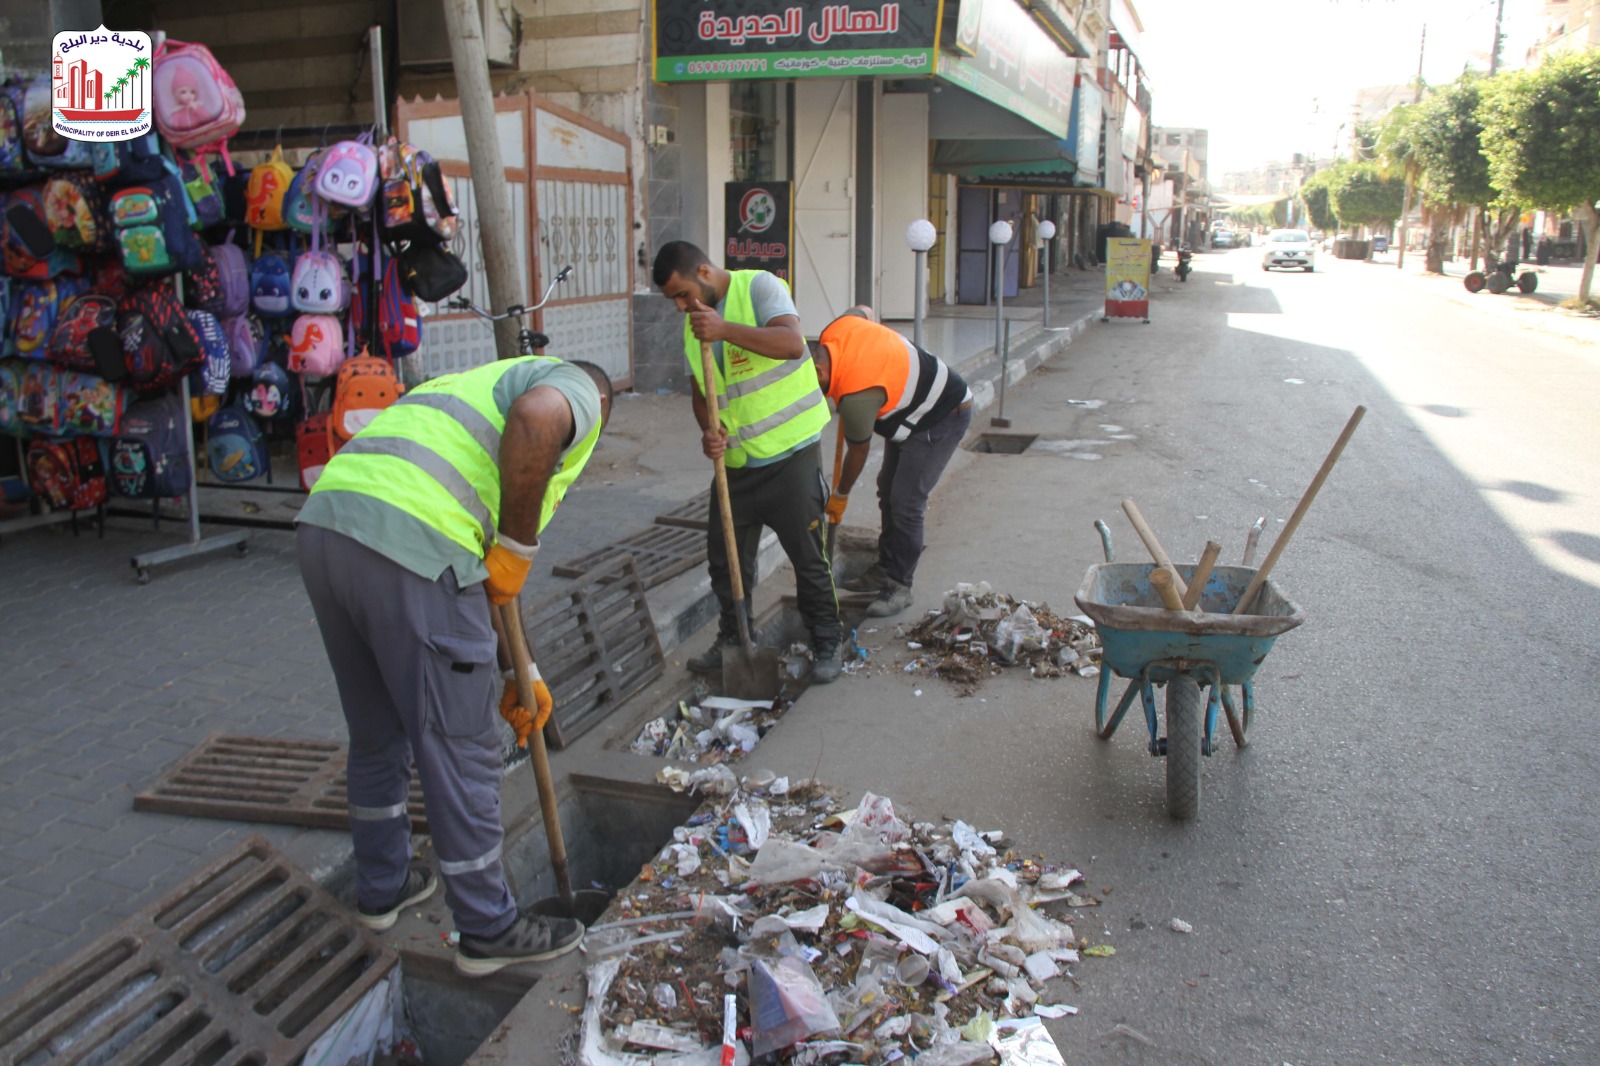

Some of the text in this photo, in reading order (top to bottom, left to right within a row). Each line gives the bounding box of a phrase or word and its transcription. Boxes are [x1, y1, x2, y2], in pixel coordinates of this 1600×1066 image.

[699, 4, 898, 45] الهلال الجديدة
[688, 59, 767, 74] 0598737771
[828, 56, 849, 67] طبية
[851, 56, 894, 68] مستلزمات
[903, 53, 926, 66] أدوية
[727, 237, 786, 262] صيدلية
